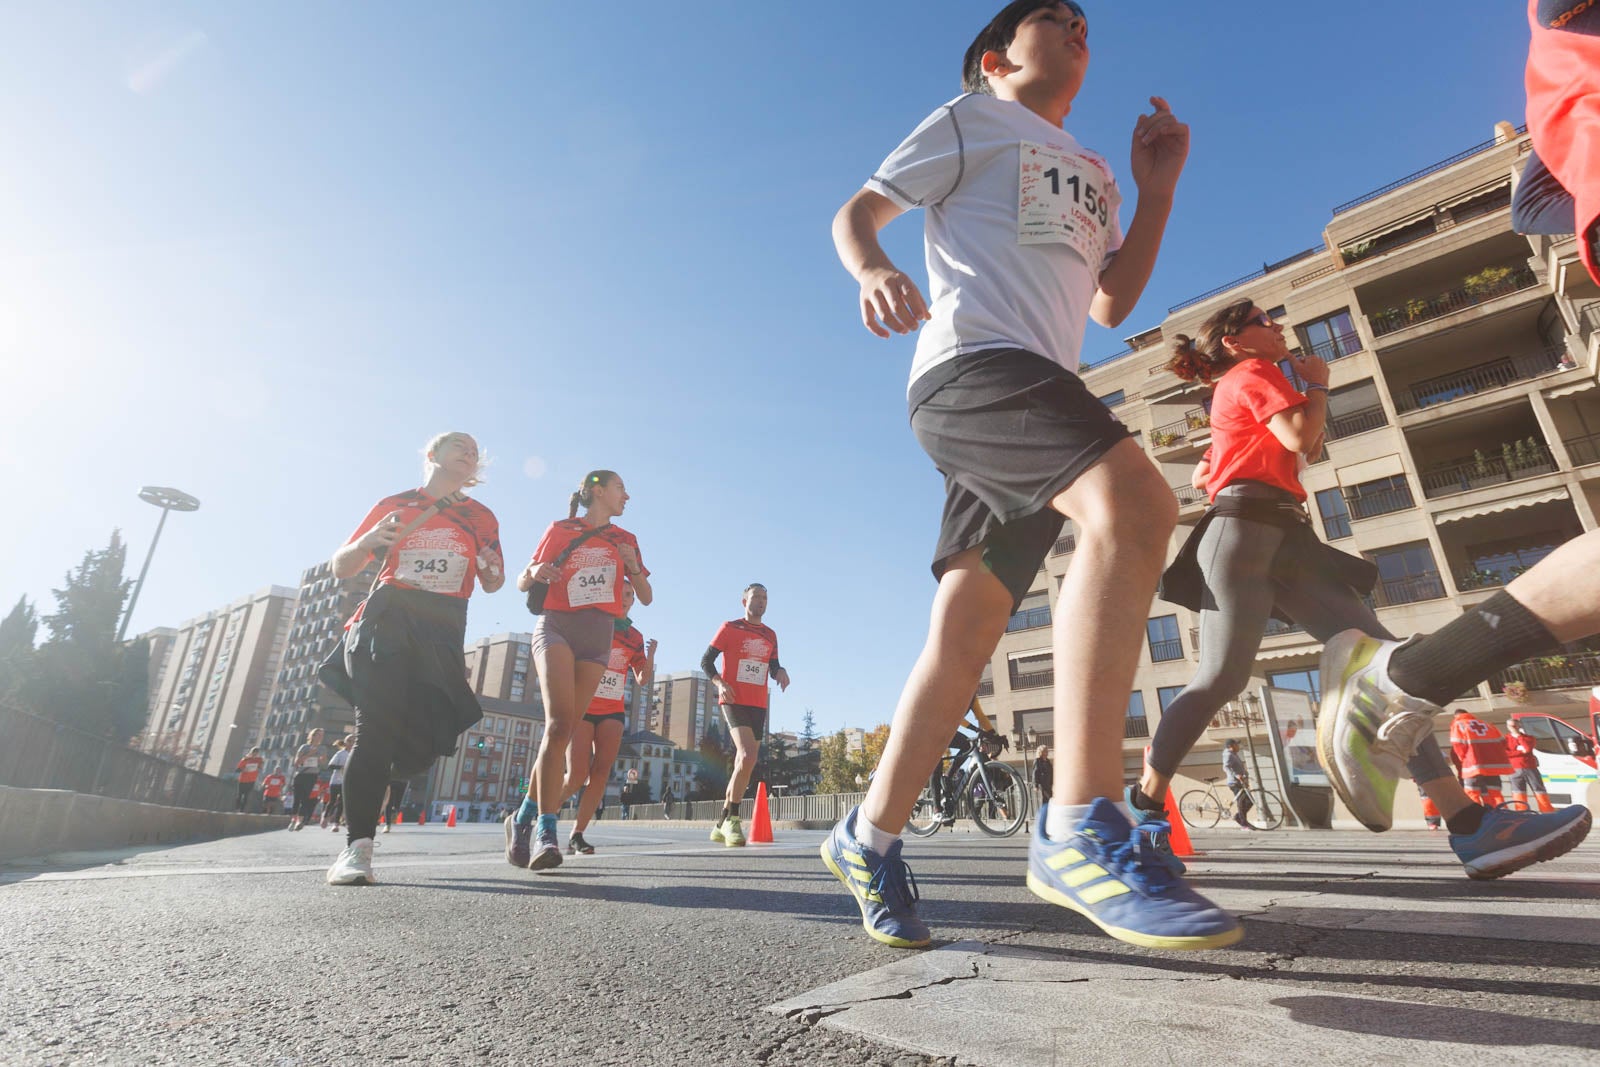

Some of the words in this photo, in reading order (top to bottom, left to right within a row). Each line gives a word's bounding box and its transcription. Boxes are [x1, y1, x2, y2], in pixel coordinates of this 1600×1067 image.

[1044, 167, 1108, 227] 1159
[406, 539, 464, 553] carrera
[414, 559, 448, 573] 343
[579, 574, 606, 588] 344
[600, 675, 617, 687] 345
